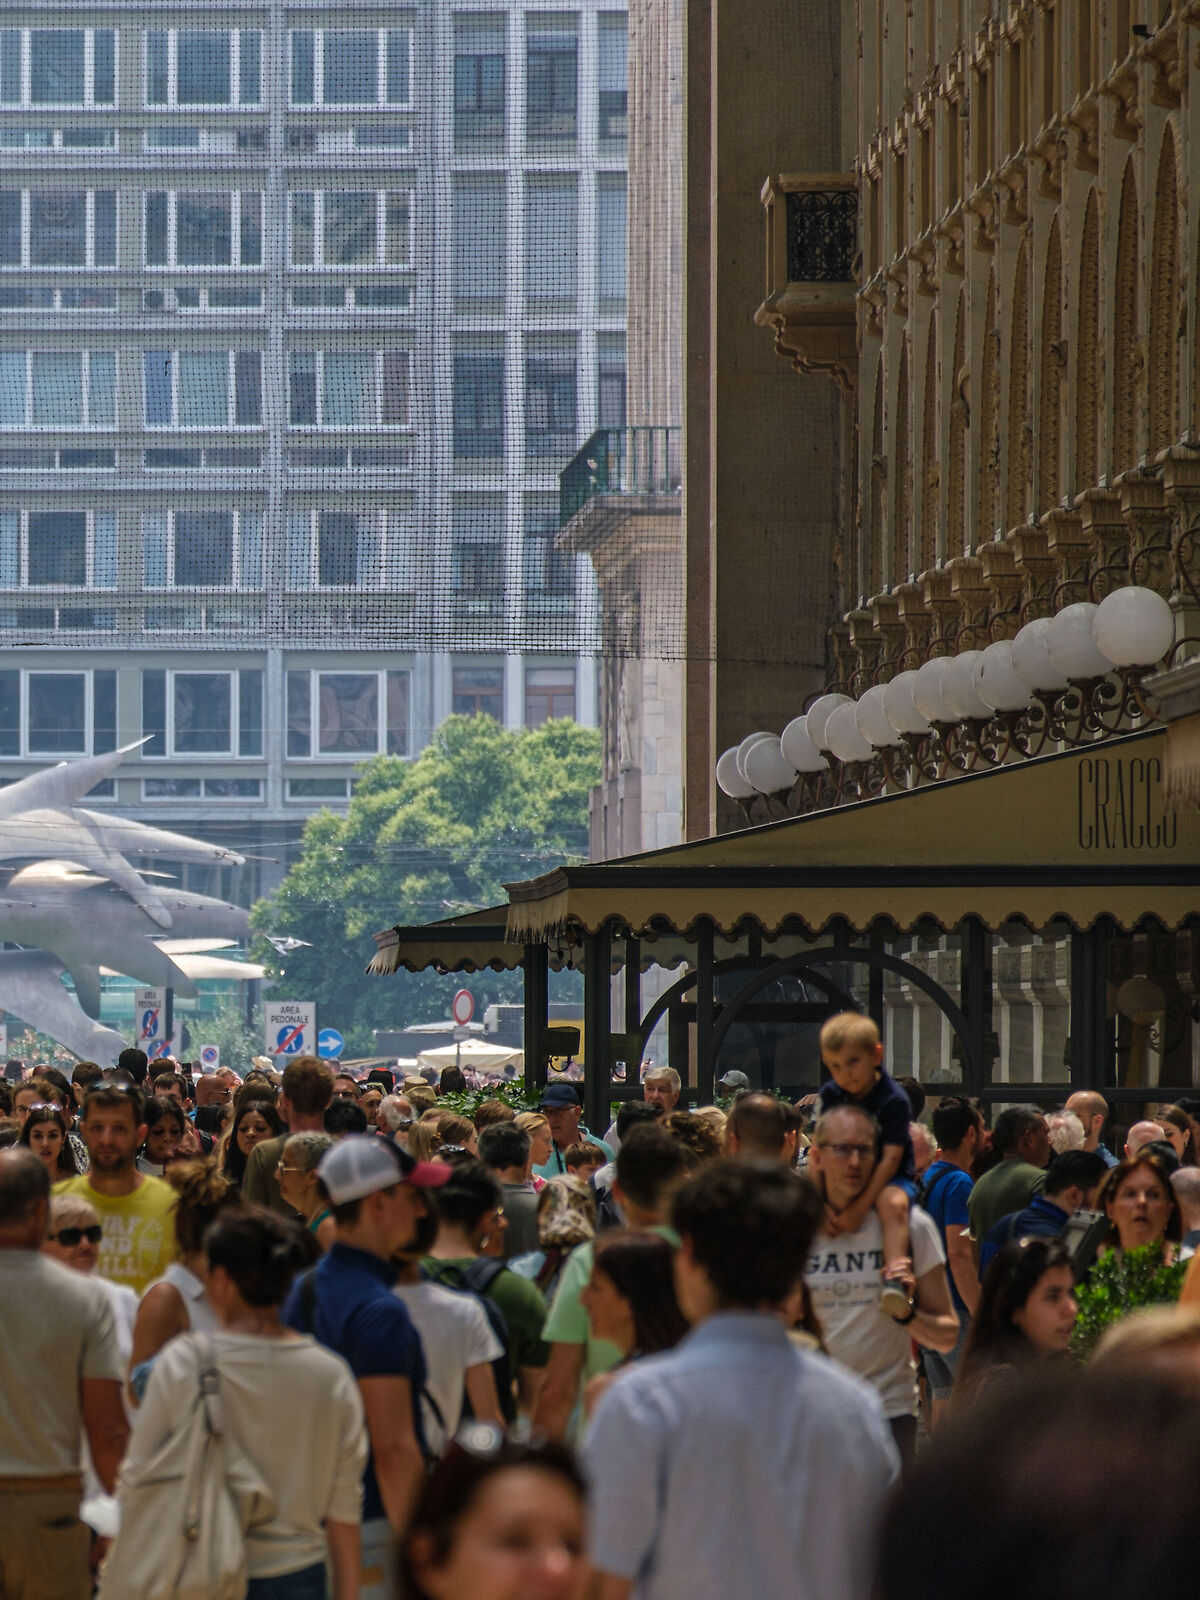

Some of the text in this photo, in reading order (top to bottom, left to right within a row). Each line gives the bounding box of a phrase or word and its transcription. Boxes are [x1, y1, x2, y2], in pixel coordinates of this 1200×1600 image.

[280, 1006, 300, 1014] AREA
[271, 1015, 309, 1024] PEDONALE
[803, 1250, 884, 1274] GANT
